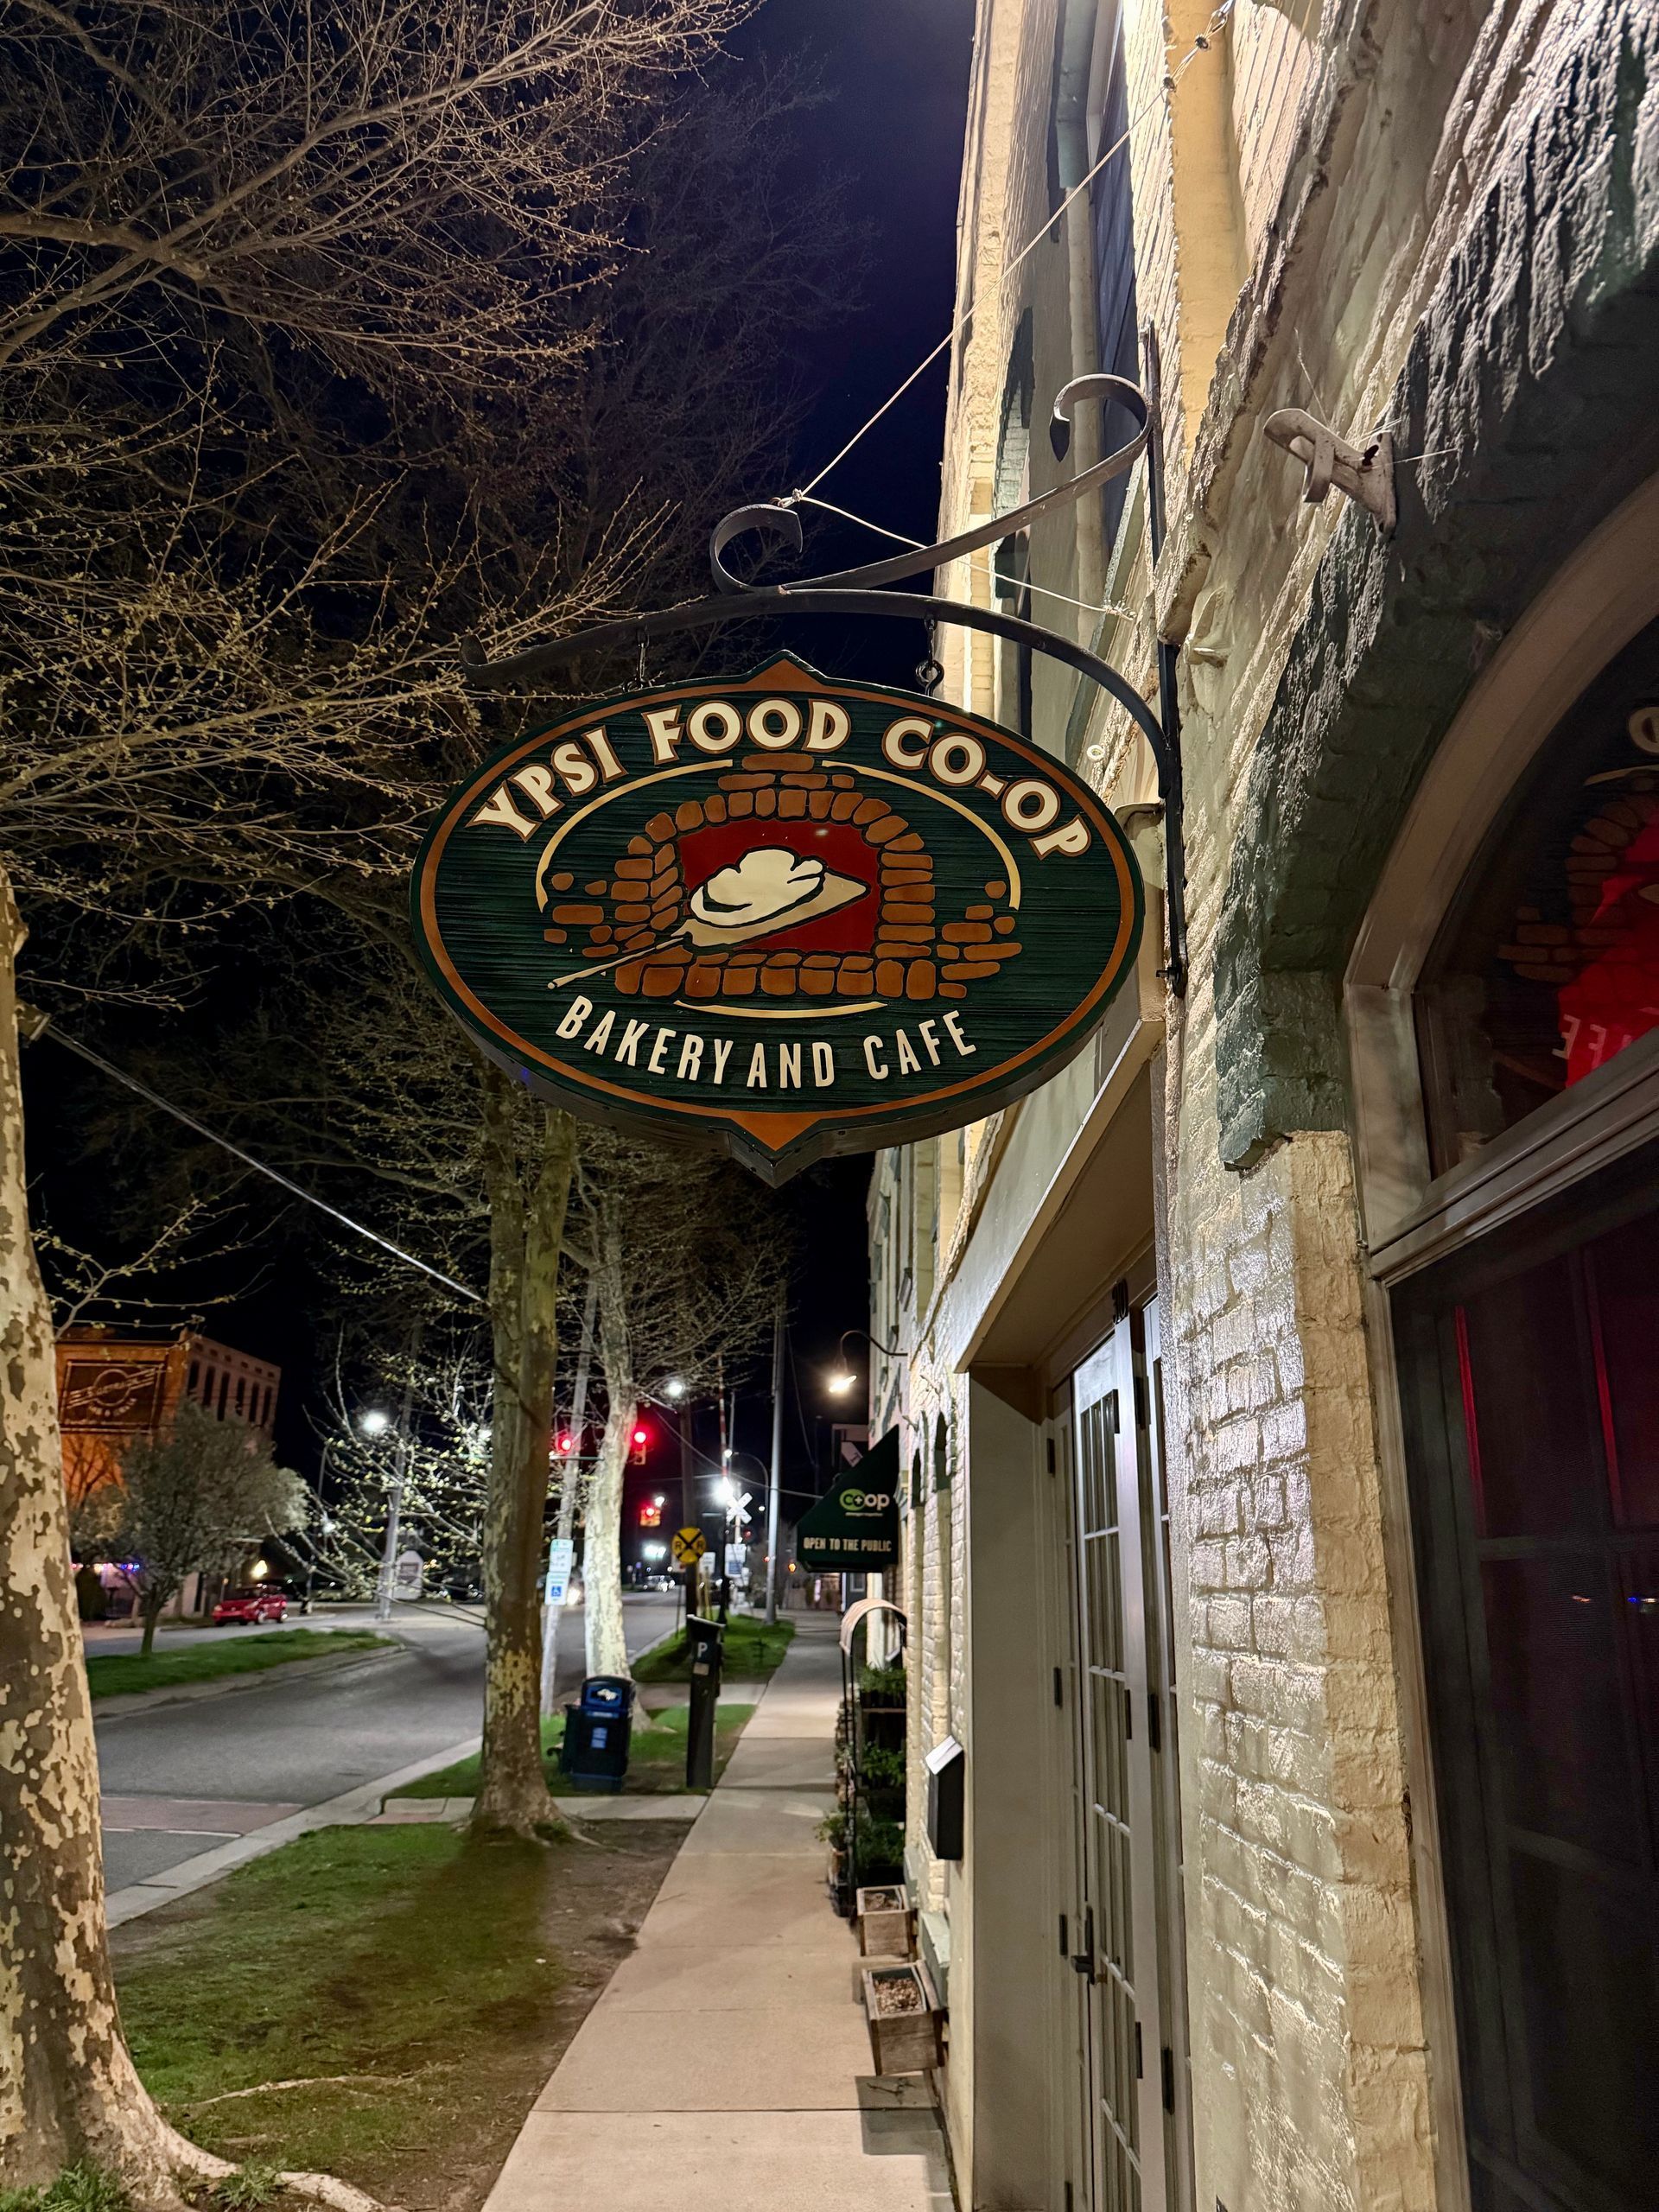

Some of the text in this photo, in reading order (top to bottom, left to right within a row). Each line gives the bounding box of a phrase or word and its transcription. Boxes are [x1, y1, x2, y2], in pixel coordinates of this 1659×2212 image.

[465, 698, 1091, 860] YPSI FOOD CO-OP
[555, 995, 977, 1089] BAKERY AND CAFE
[804, 1538, 892, 1552] OPEN TO THE PUBLIC
[696, 1642, 709, 1659] P
